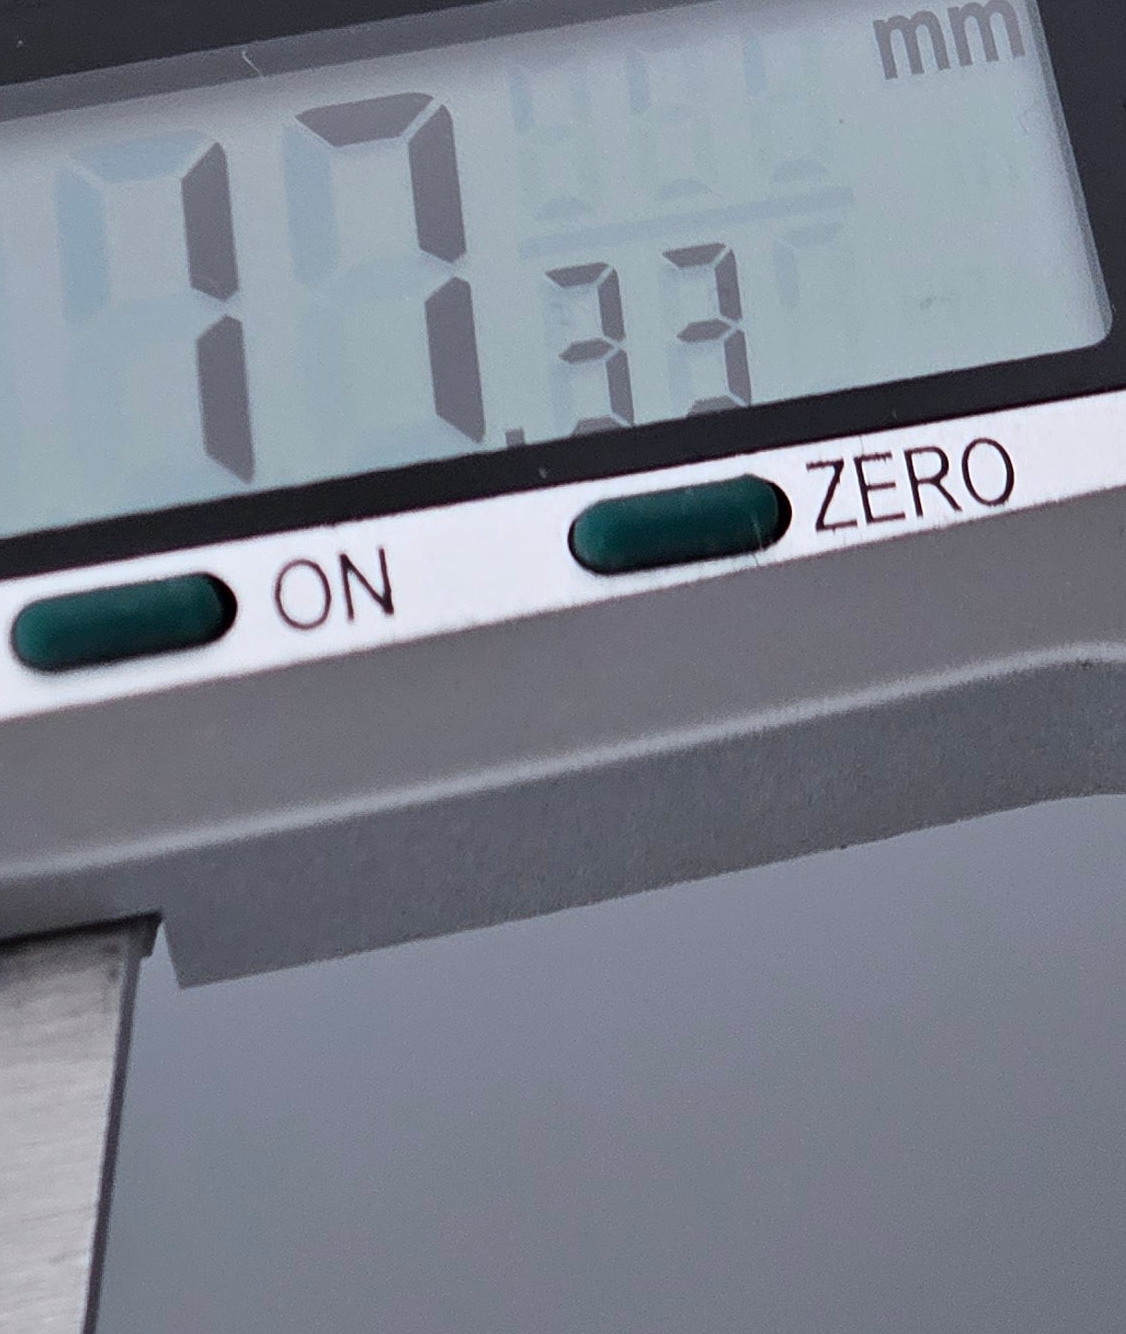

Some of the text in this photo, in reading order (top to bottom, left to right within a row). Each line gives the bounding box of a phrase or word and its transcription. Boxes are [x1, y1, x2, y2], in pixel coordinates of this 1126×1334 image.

[180, 91, 752, 484] 17.33
[805, 437, 1016, 533] ZERO
[274, 548, 395, 630] ON
